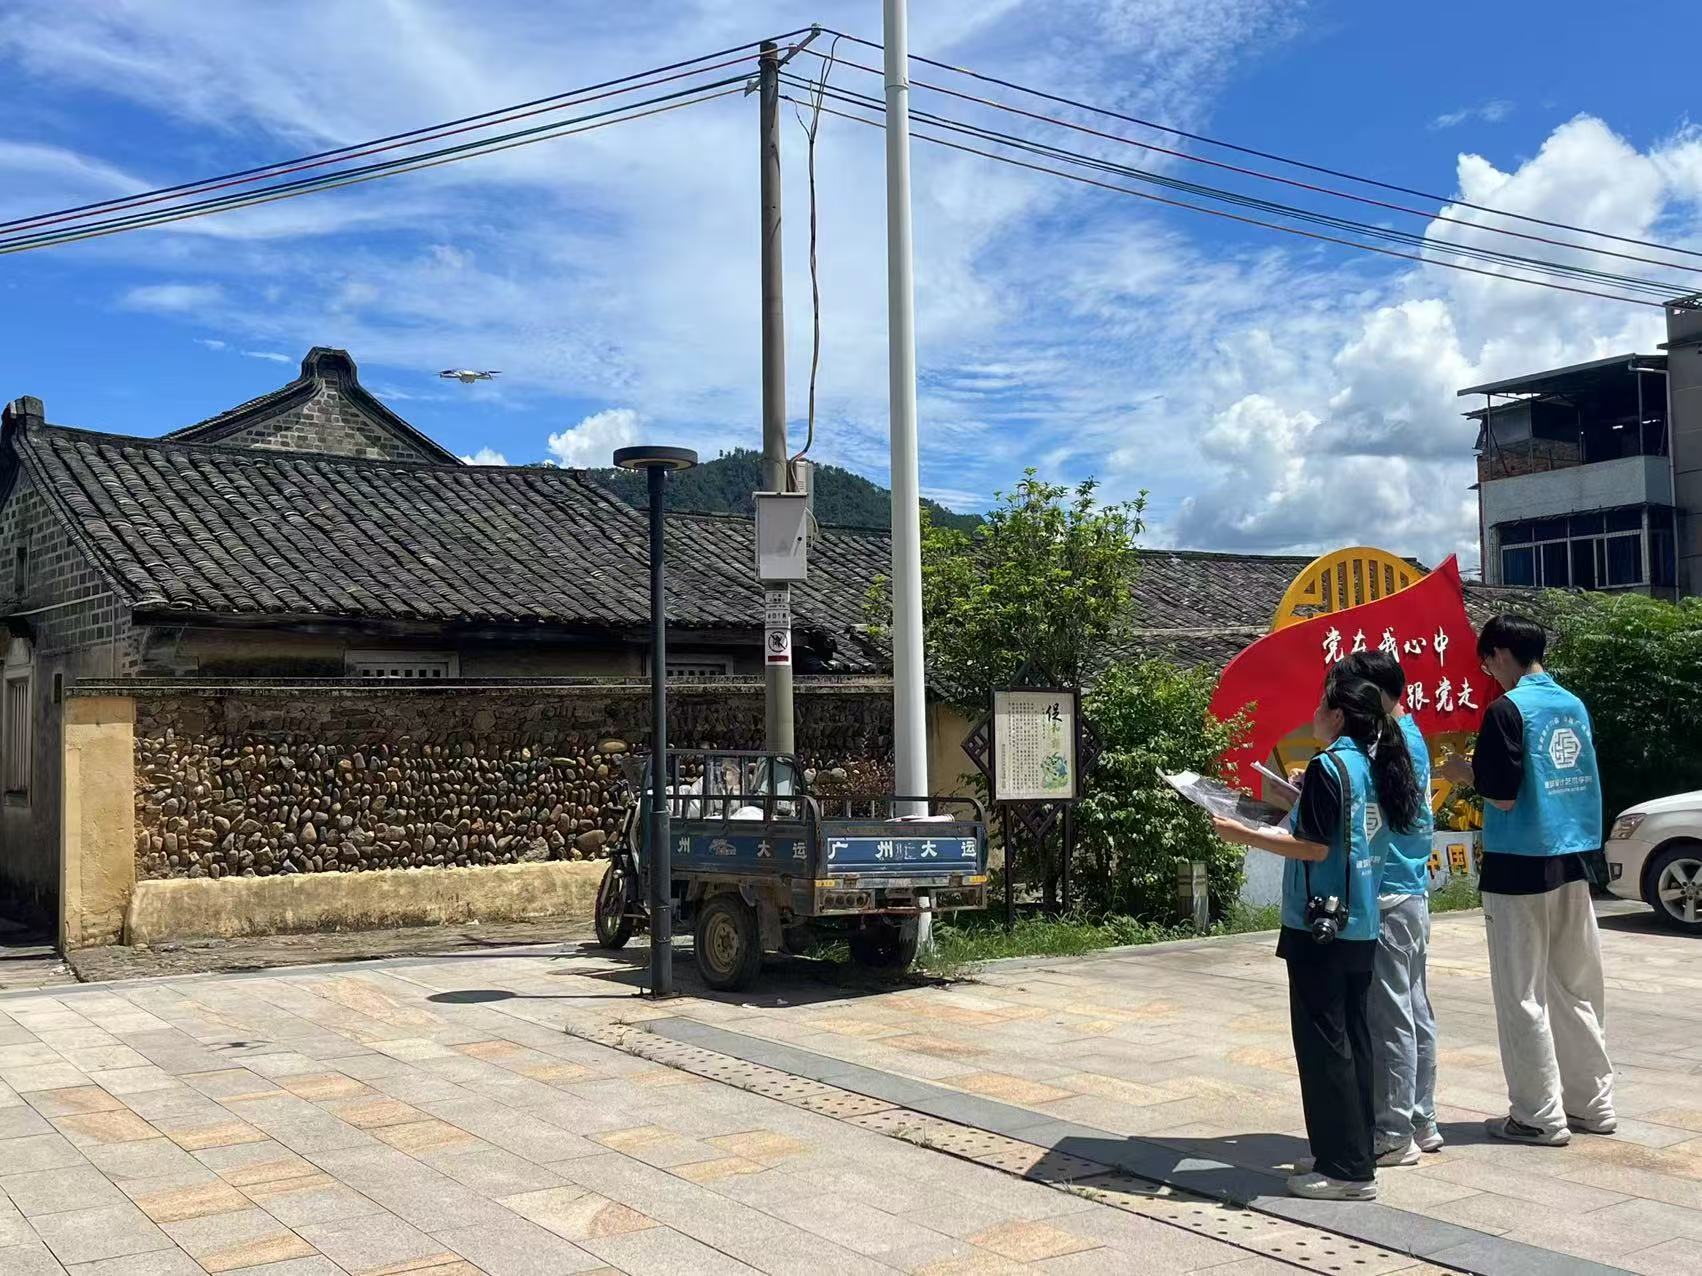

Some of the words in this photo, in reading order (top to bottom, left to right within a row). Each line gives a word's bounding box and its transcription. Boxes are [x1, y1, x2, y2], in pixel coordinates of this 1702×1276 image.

[1322, 625, 1449, 667] 党在我心中
